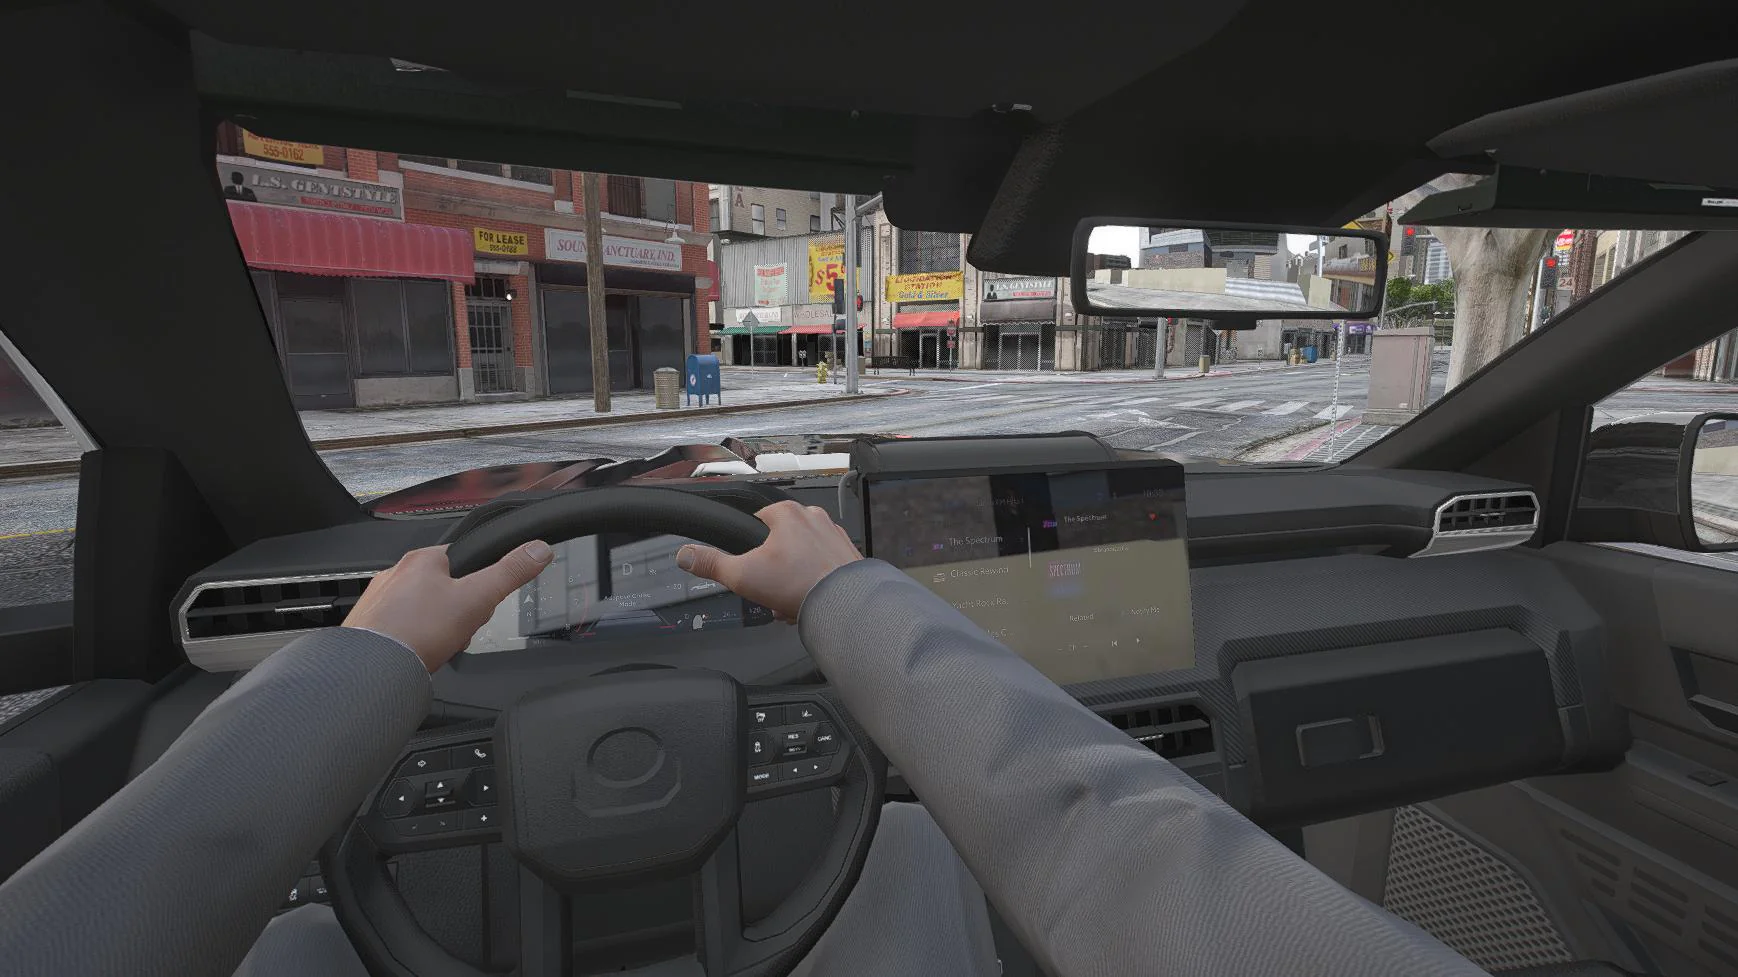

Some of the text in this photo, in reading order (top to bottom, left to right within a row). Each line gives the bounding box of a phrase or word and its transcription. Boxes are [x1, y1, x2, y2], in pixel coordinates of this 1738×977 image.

[263, 144, 304, 161] 555-0162
[252, 174, 288, 190] L.S.
[479, 231, 525, 245] FOR LEASE
[557, 238, 587, 253] SOUN
[948, 535, 1003, 546] The Spectrum
